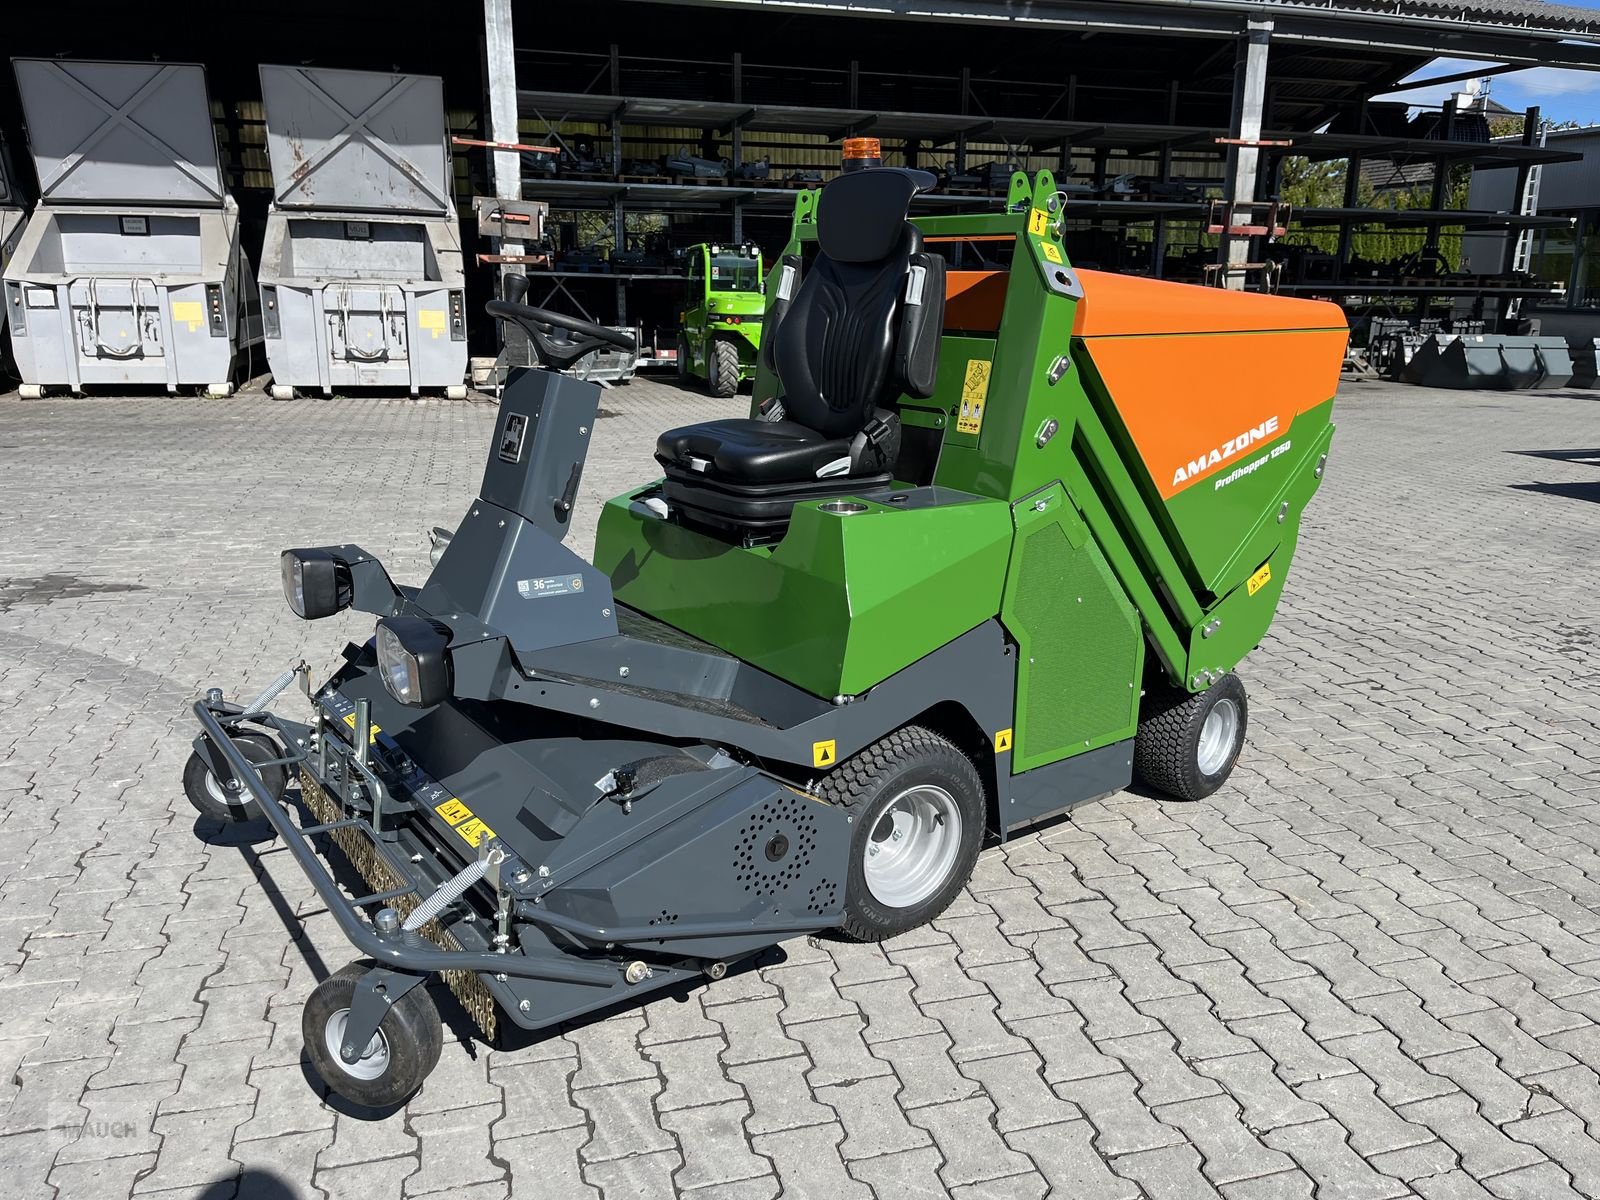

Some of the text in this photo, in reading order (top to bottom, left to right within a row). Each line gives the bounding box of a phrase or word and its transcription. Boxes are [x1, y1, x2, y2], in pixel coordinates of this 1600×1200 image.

[1172, 415, 1279, 487] AMAZONE
[1214, 440, 1292, 491] Profihopper 1250
[532, 579, 545, 590] 36
